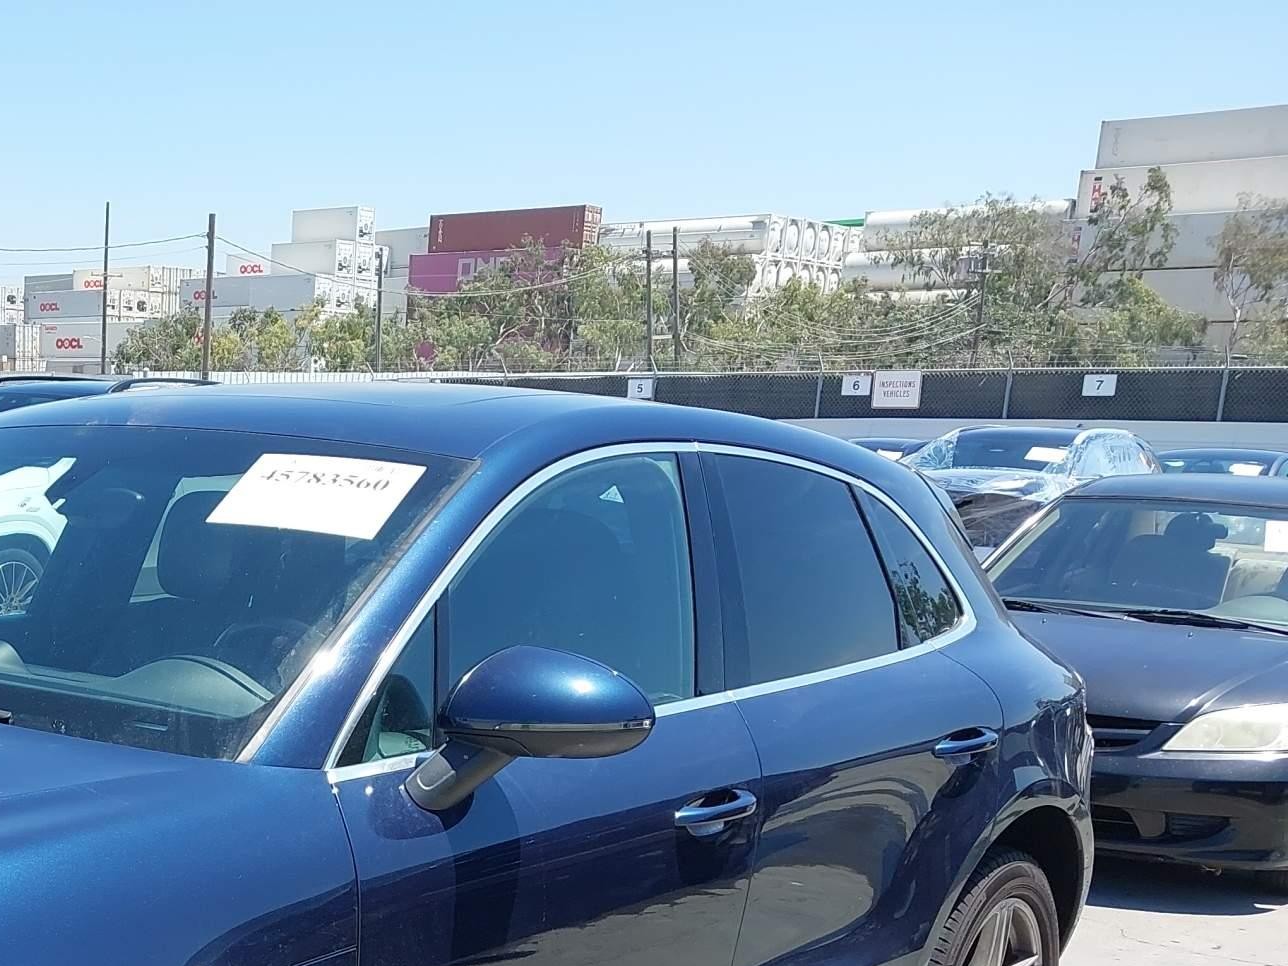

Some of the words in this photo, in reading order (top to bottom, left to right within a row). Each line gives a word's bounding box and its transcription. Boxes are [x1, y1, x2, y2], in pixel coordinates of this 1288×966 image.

[240, 264, 263, 274] OOCL
[193, 290, 217, 300] OOL
[40, 303, 60, 311] OOCL
[56, 338, 83, 349] OOCL
[636, 384, 643, 393] 5
[852, 380, 860, 391] 6
[1095, 380, 1104, 391] 7
[260, 469, 390, 490] 45783560
